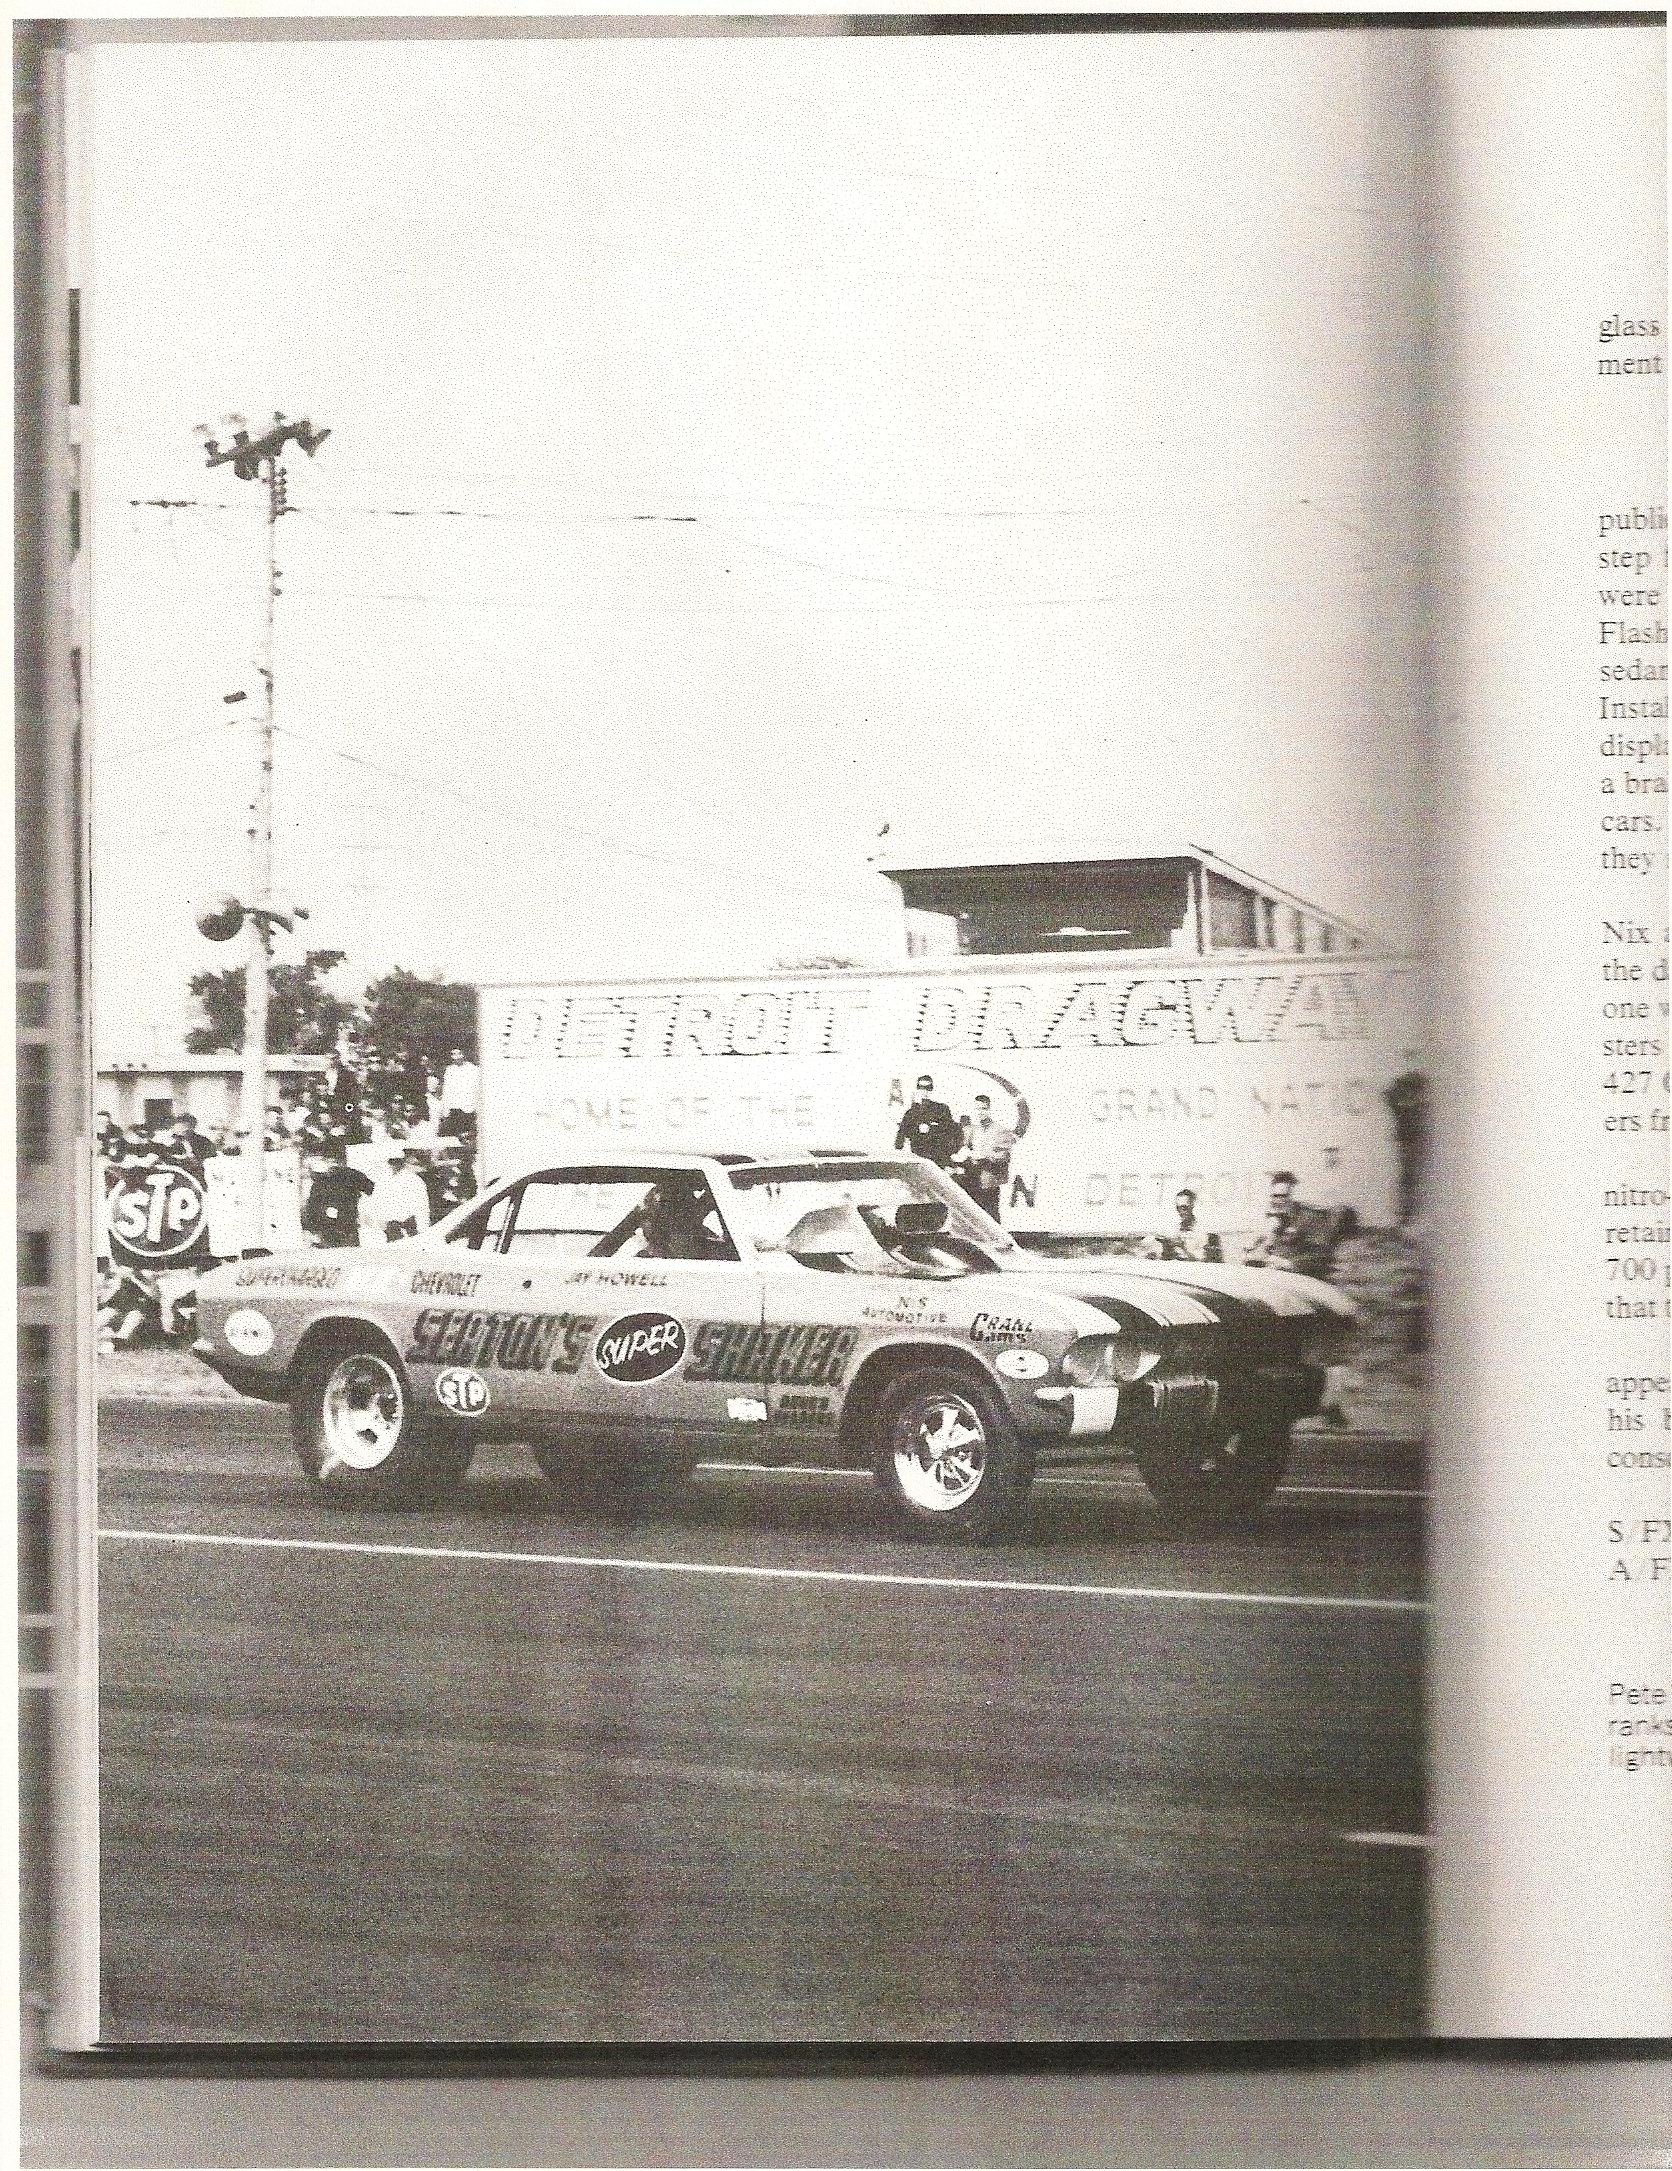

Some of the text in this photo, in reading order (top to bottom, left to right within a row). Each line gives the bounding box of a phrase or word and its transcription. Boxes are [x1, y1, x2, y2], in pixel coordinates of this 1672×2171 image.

[1599, 314, 1660, 342] glass
[1598, 356, 1662, 375] ment
[1599, 551, 1651, 575] step
[1599, 590, 1660, 606] were
[1601, 777, 1614, 794] a
[1601, 815, 1661, 831] cars.
[1601, 846, 1654, 875] they
[1602, 920, 1651, 943] Nix
[1602, 958, 1642, 981] the
[1603, 1002, 1650, 1018] one
[502, 989, 871, 1059] DETROIT
[1603, 1039, 1664, 1056] sters
[1603, 1071, 1651, 1094] 427
[532, 1096, 638, 1131] HOME
[665, 1095, 711, 1129] OF
[739, 1094, 815, 1128] THE
[1088, 1085, 1220, 1124] GRAND
[1605, 1116, 1642, 1131] ers
[114, 1172, 201, 1243] STP
[596, 1271, 668, 1286] HOWELL
[1605, 1257, 1655, 1280] 700
[861, 1306, 948, 1324] AUTOMOTIVE
[1606, 1295, 1656, 1318] that
[405, 1308, 860, 1387] SEATON'S SUPER SHAKER
[440, 1372, 487, 1410] STP
[1608, 1408, 1646, 1430] his
[1610, 1683, 1666, 1705] Pete
